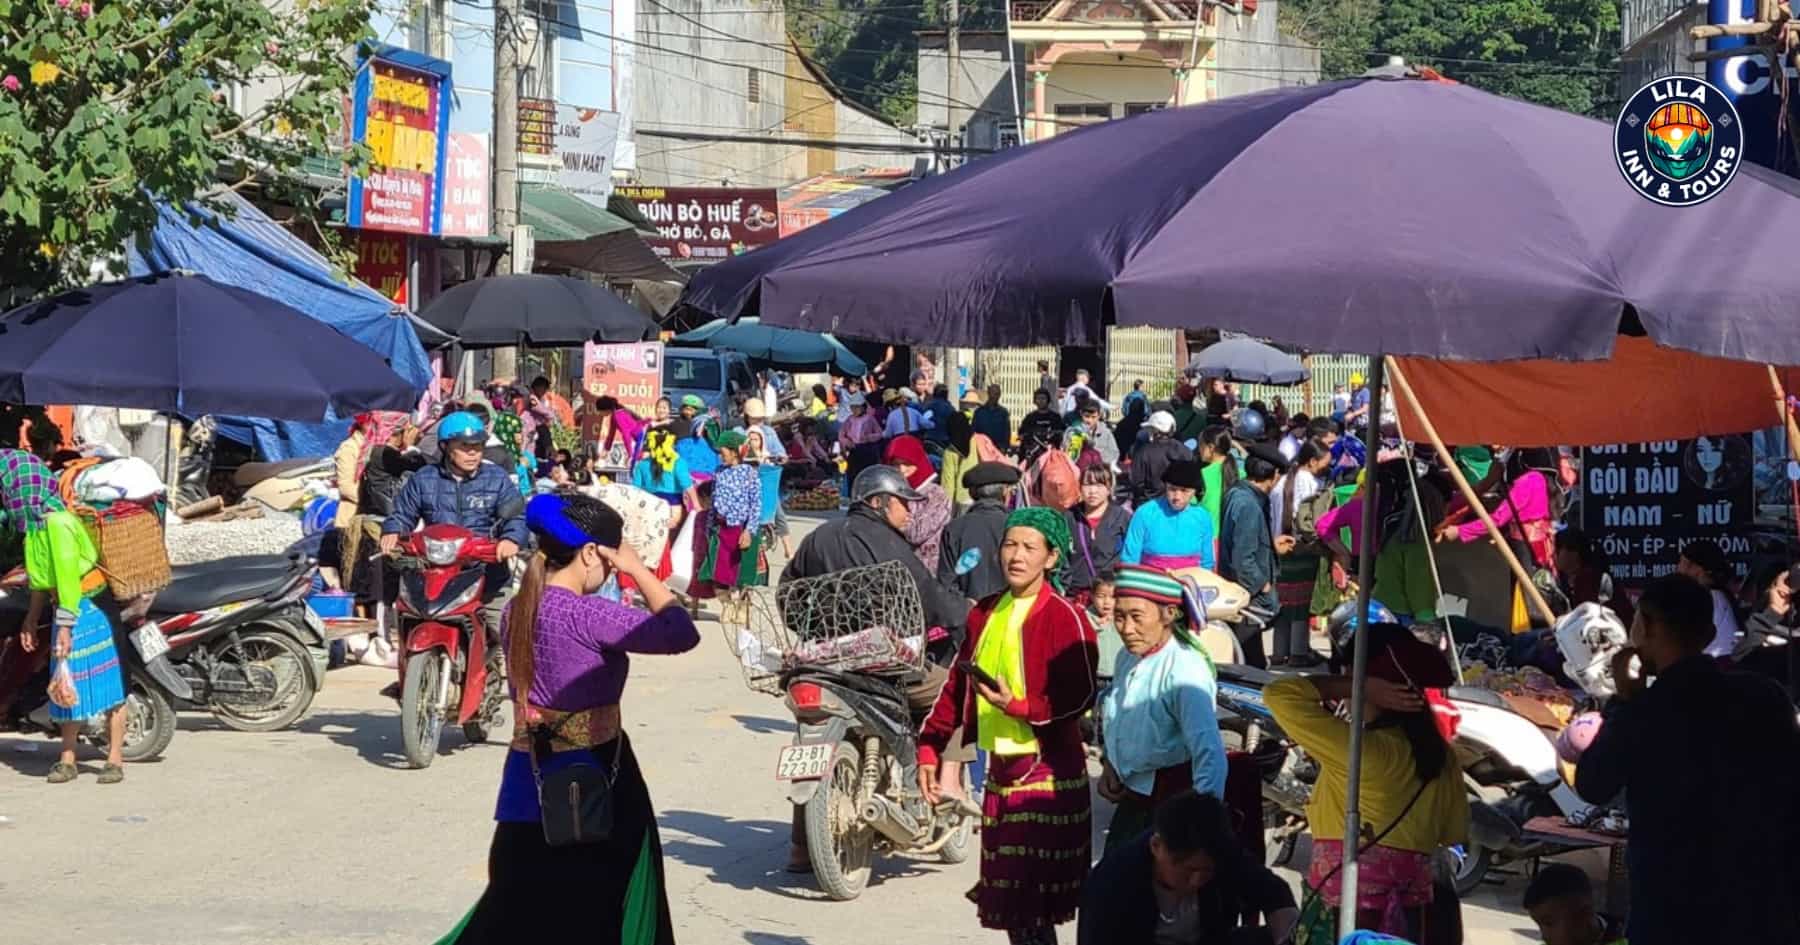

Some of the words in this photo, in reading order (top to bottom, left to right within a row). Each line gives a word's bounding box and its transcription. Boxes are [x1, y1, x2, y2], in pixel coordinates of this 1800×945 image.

[562, 151, 581, 171] MINI
[582, 153, 606, 173] MART
[638, 199, 673, 222] BÚN
[677, 199, 703, 222] BÒ
[707, 198, 744, 222] HUẾ
[656, 225, 681, 240] HỞ
[711, 227, 732, 240] GÀ
[1590, 462, 1627, 500] GỘI
[1635, 456, 1679, 494] ĐẦU
[1603, 505, 1663, 527] NAM
[1697, 500, 1733, 526] NỮ
